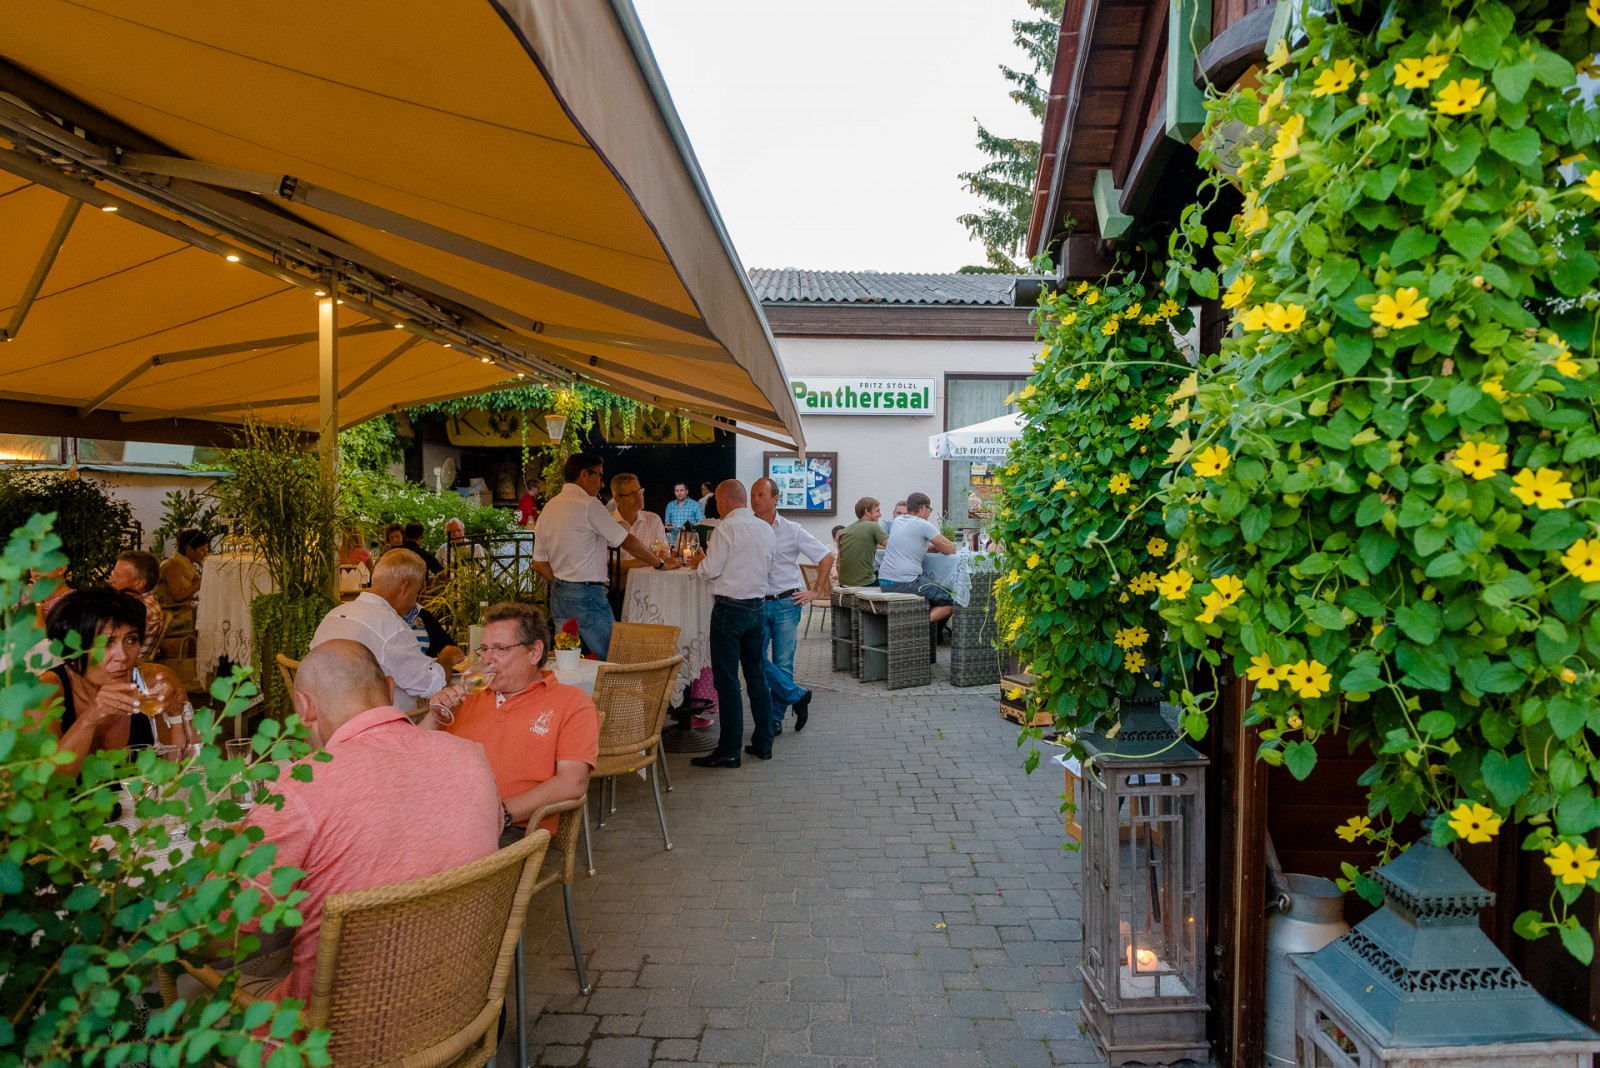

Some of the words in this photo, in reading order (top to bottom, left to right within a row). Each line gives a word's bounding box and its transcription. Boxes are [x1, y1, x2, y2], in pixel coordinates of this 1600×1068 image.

[886, 381, 917, 389] STÖLZL
[790, 381, 929, 409] Panthersaal
[973, 436, 1022, 444] BRAUKUNS
